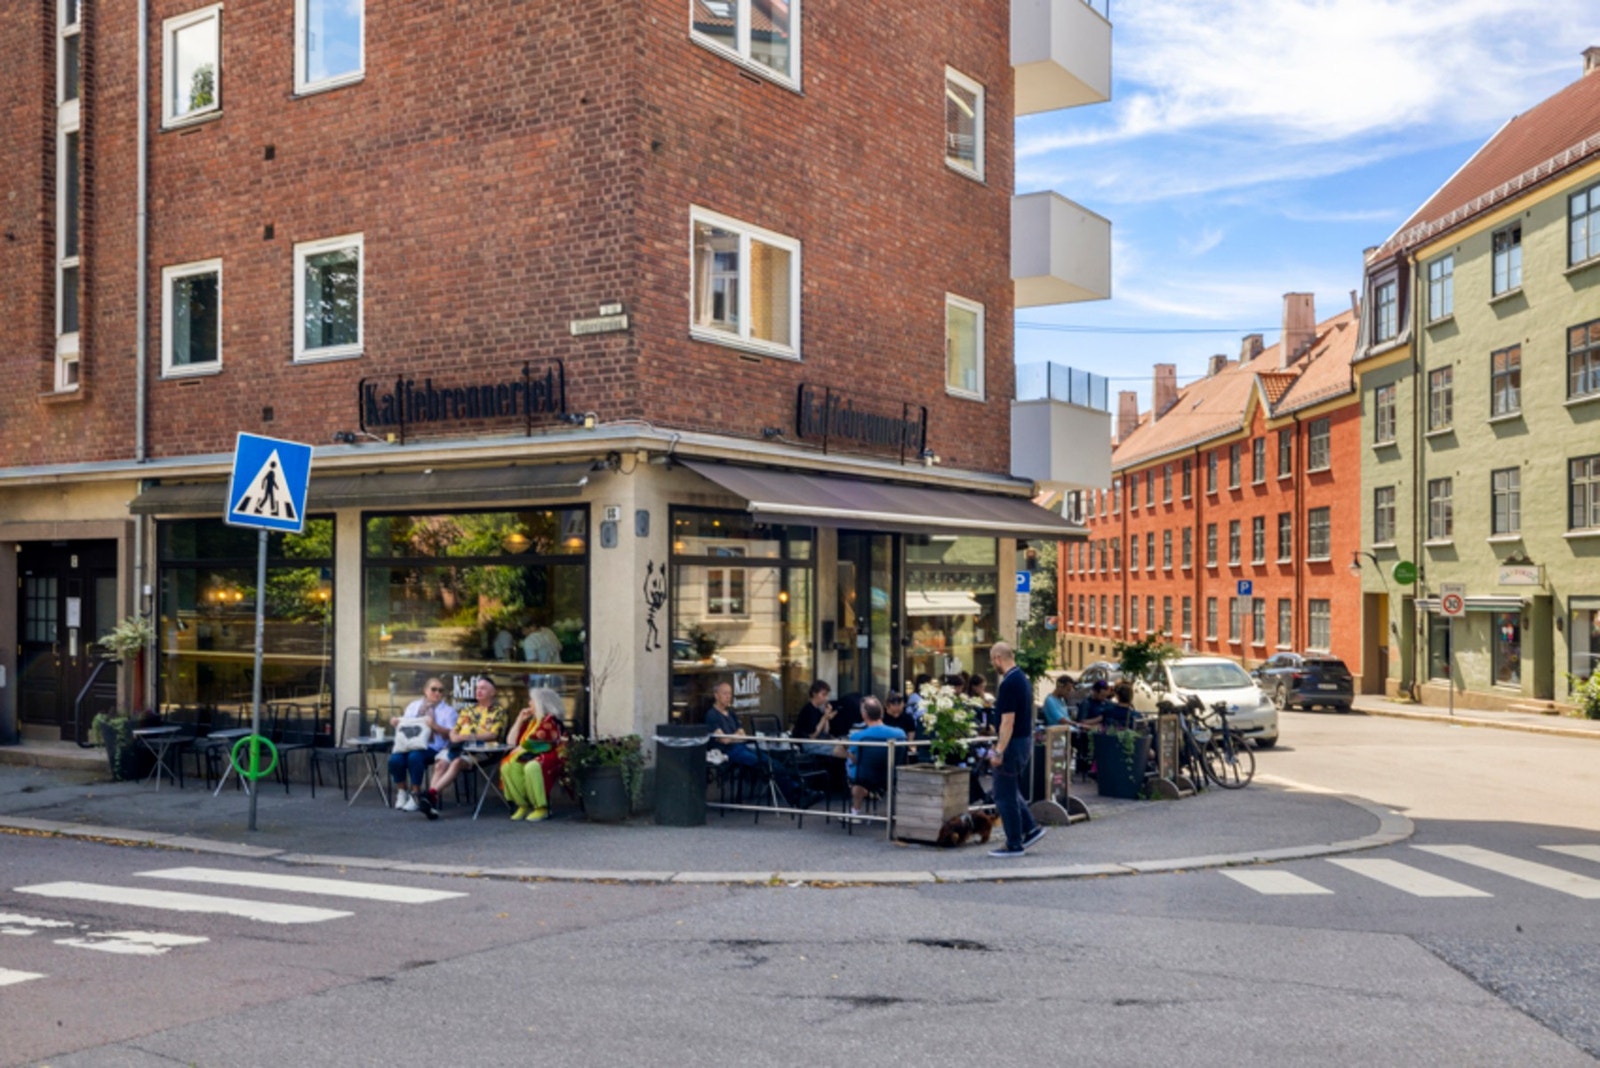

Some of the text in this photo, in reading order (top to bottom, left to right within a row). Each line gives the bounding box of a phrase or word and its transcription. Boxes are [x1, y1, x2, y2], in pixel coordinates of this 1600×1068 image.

[364, 367, 557, 427] Kaffebrenneriet
[1240, 581, 1250, 594] P
[1447, 600, 1460, 609] 30
[733, 671, 761, 695] Kaffe
